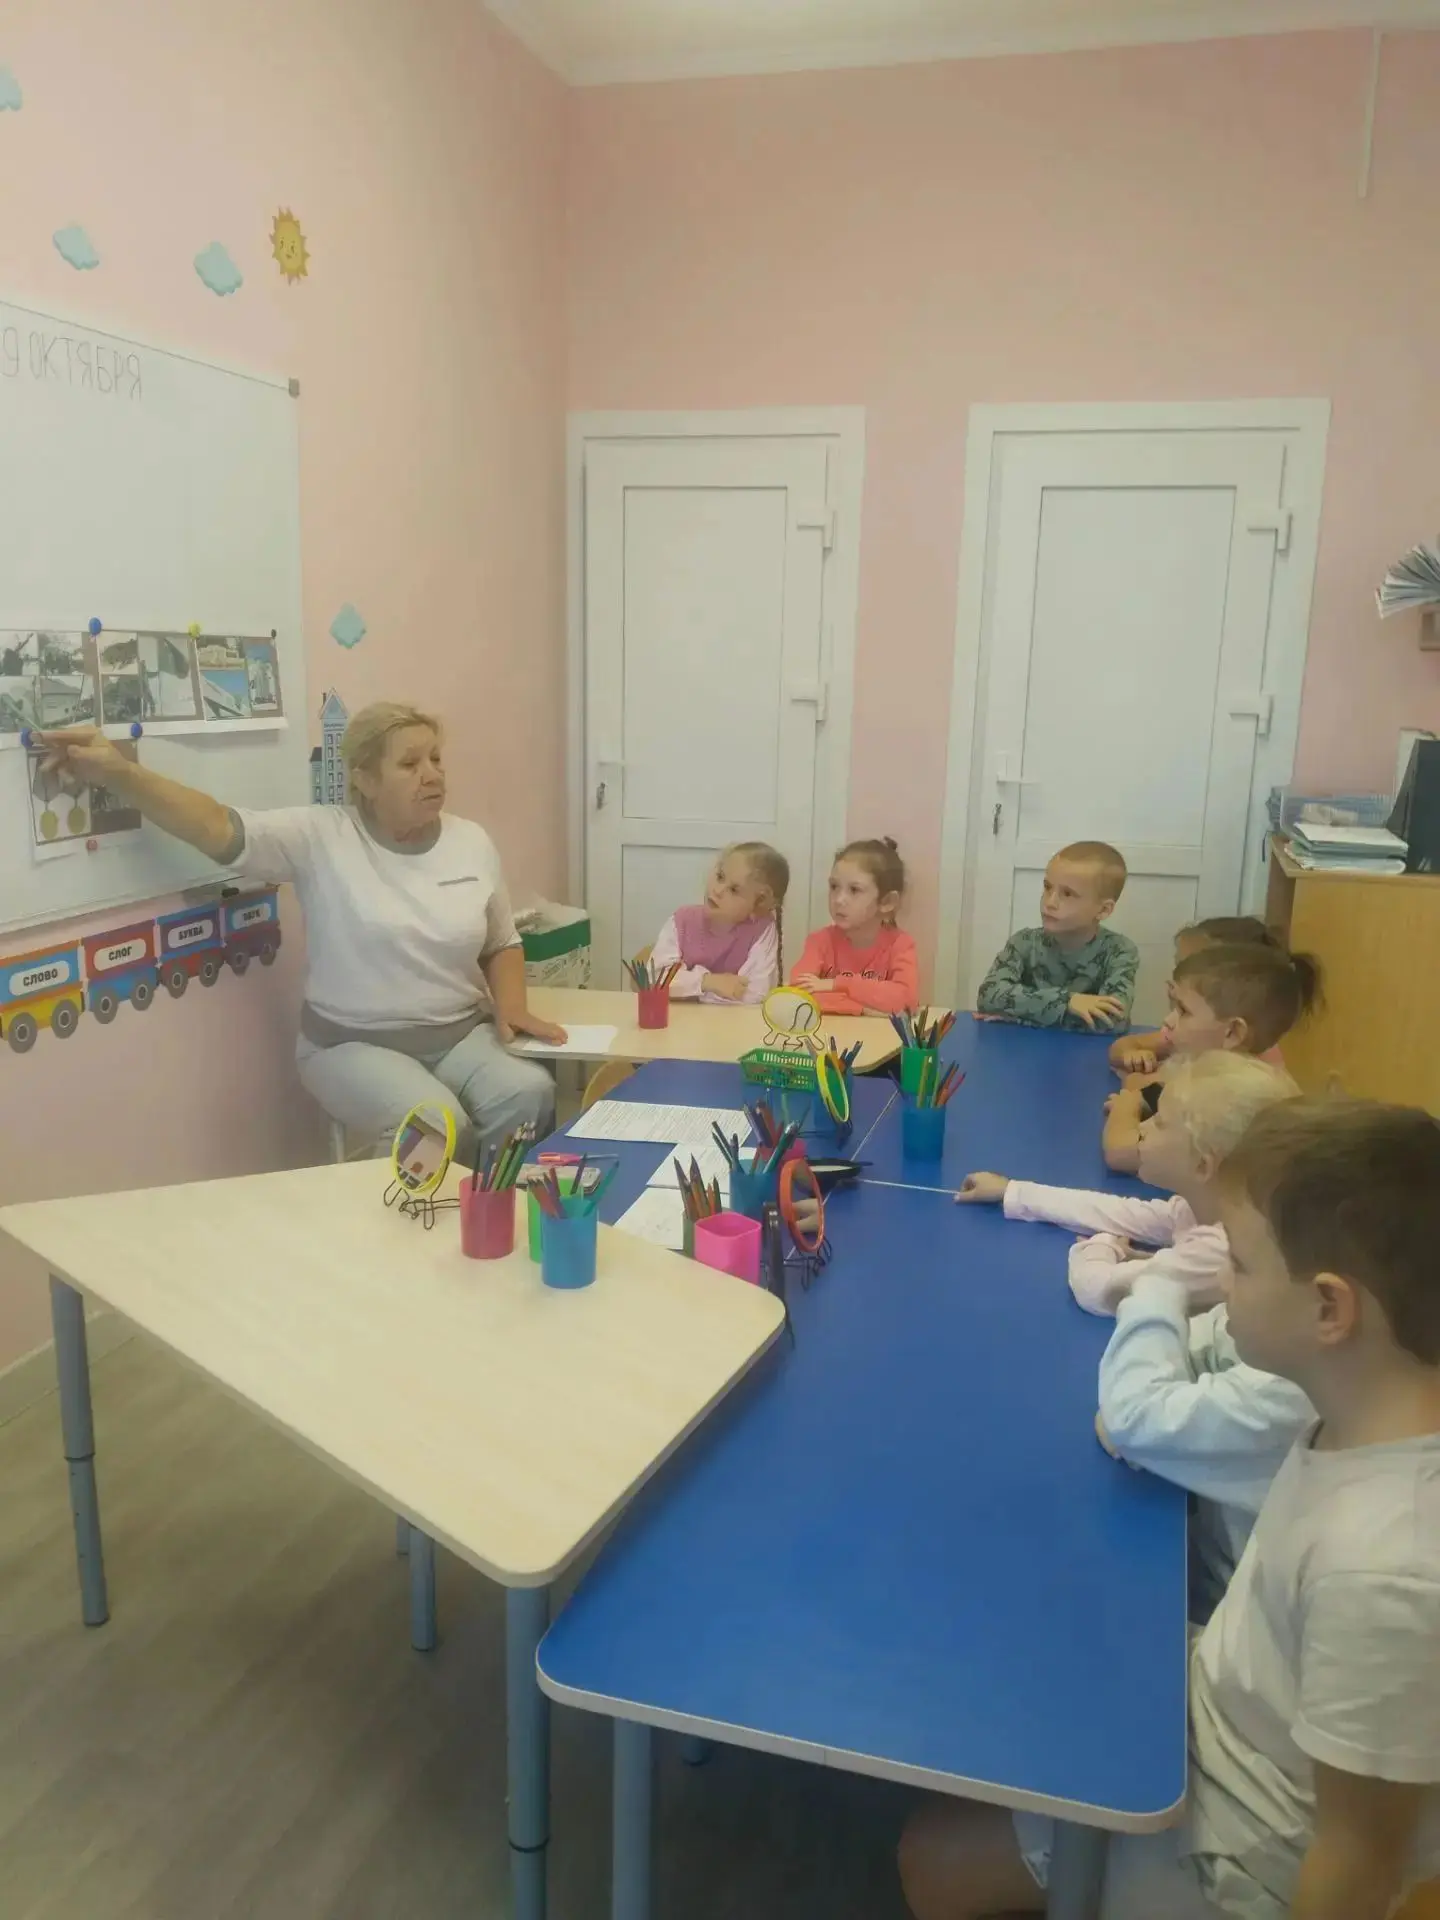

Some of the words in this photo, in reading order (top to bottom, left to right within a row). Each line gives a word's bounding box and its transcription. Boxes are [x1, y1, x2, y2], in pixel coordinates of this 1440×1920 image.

[28, 331, 142, 402] ОКТЯБРЯ
[178, 925, 204, 941] БУКВА
[108, 946, 133, 962] СЛОГ
[23, 968, 59, 987] СЛОВО
